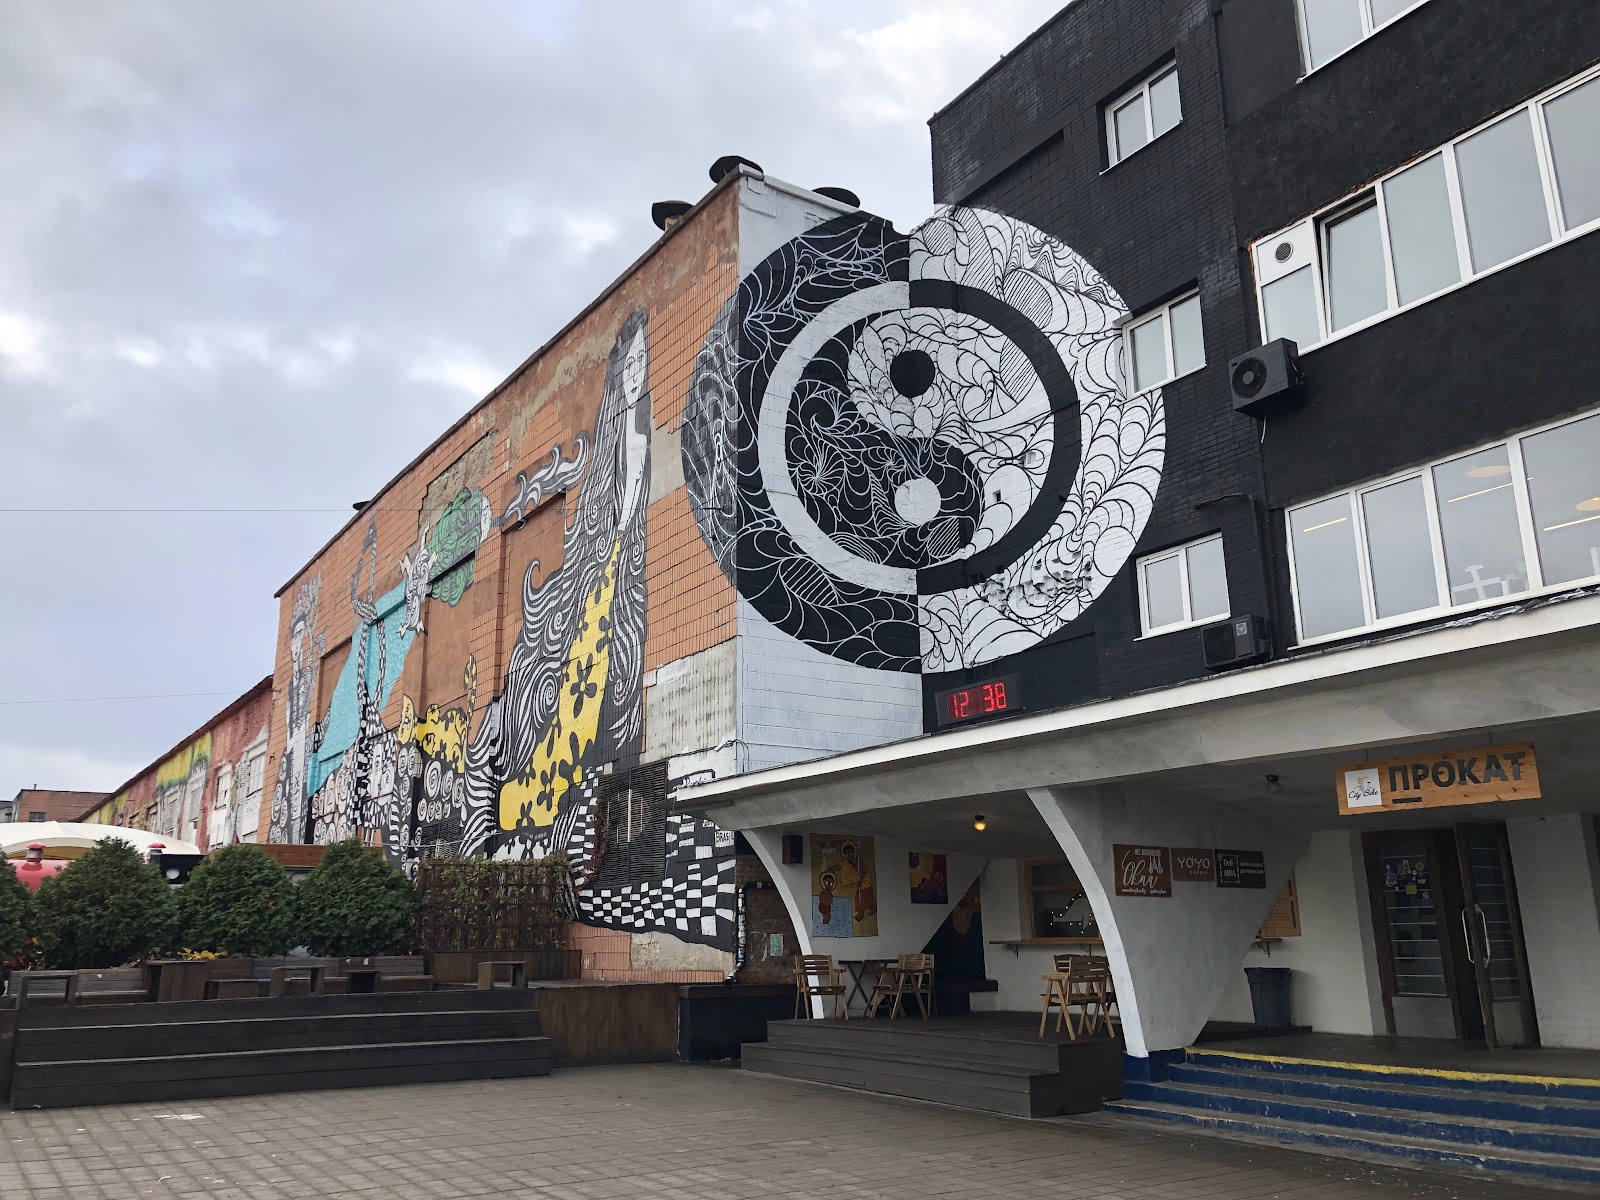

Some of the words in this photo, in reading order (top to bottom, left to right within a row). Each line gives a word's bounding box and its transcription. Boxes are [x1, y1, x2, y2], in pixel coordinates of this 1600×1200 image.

[953, 691, 969, 718] 12
[982, 682, 1007, 712] 38
[1388, 751, 1526, 792] ПРОКАТ
[1348, 790, 1361, 800] City
[1363, 788, 1378, 797] Bike
